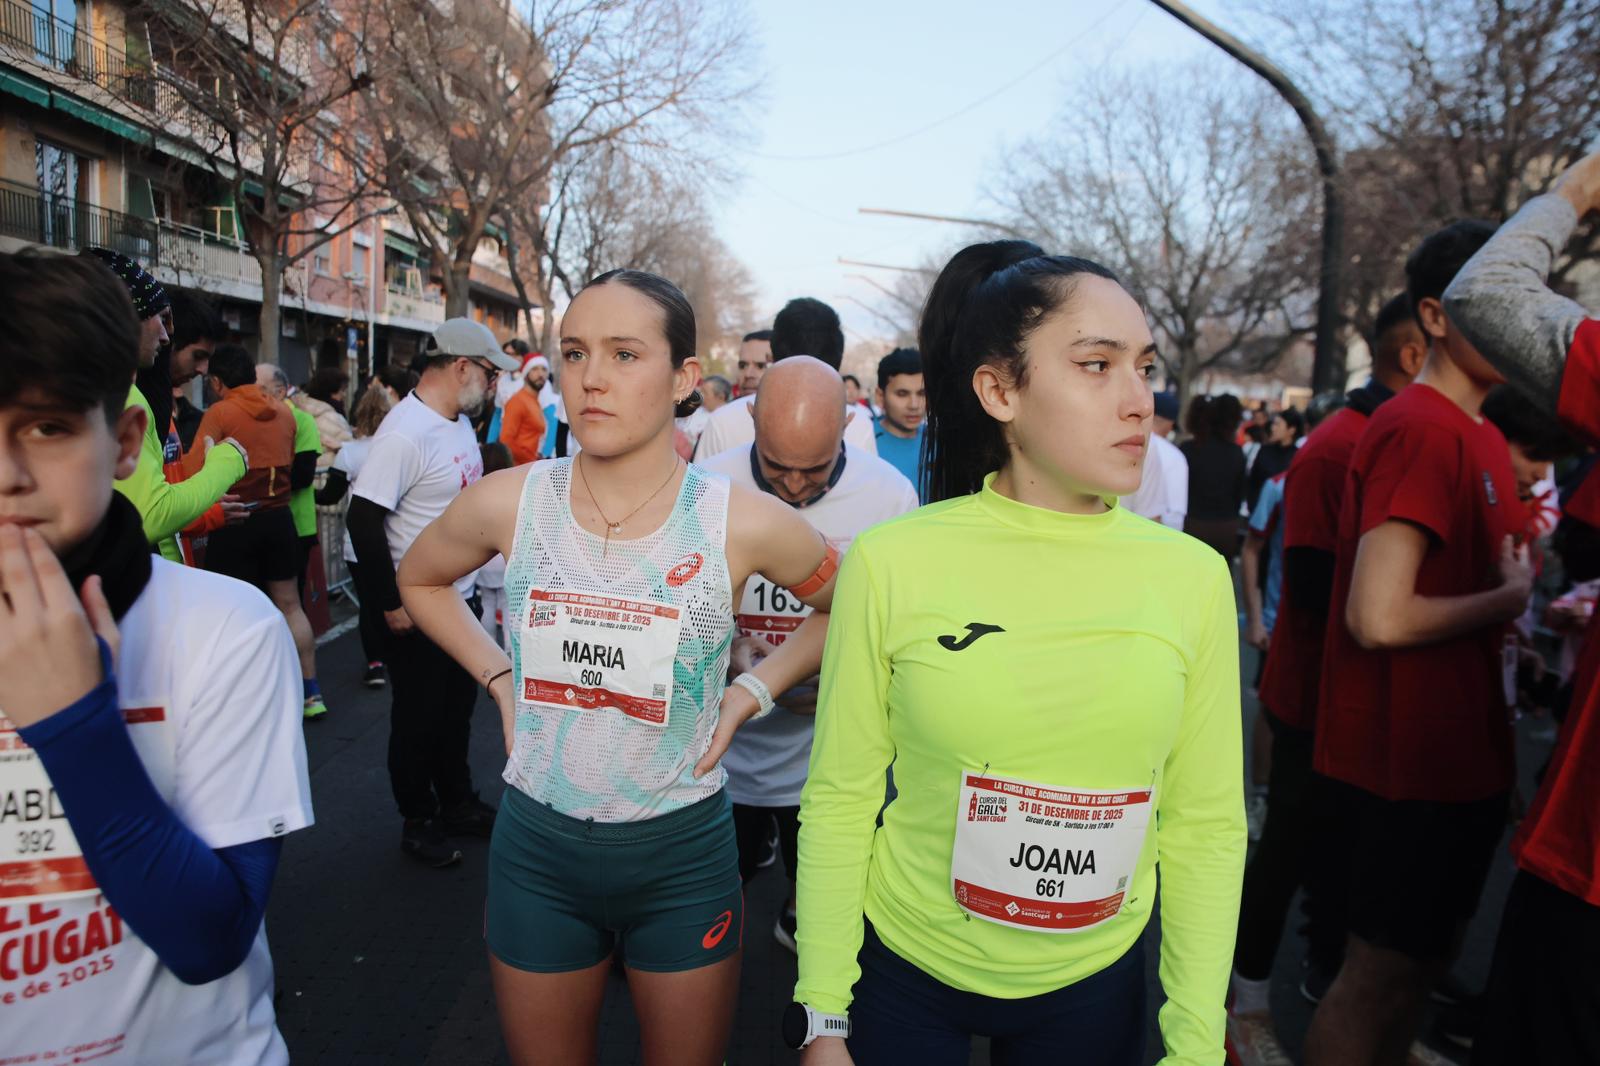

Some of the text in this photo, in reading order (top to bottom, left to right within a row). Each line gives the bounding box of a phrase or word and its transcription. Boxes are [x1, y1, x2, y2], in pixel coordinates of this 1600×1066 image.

[565, 606, 652, 626] 31 DE DESEMBRE DE 2025
[562, 640, 625, 670] MARIA
[580, 669, 602, 686] 600
[994, 782, 1128, 804] LA CURSA QUE ACOMIADA L'ANY A SANT CUGAT
[978, 805, 999, 815] GALL
[1019, 801, 1124, 820] 31 DE DESEMBRE DE 2025
[1025, 816, 1044, 825] Circuit
[1064, 822, 1083, 830] Sortida
[17, 829, 56, 853] 392
[1010, 842, 1096, 875] JOANA
[1036, 878, 1065, 898] 661
[0, 904, 122, 981] CUGAT
[22, 980, 51, 999] de
[58, 954, 114, 988] 2025
